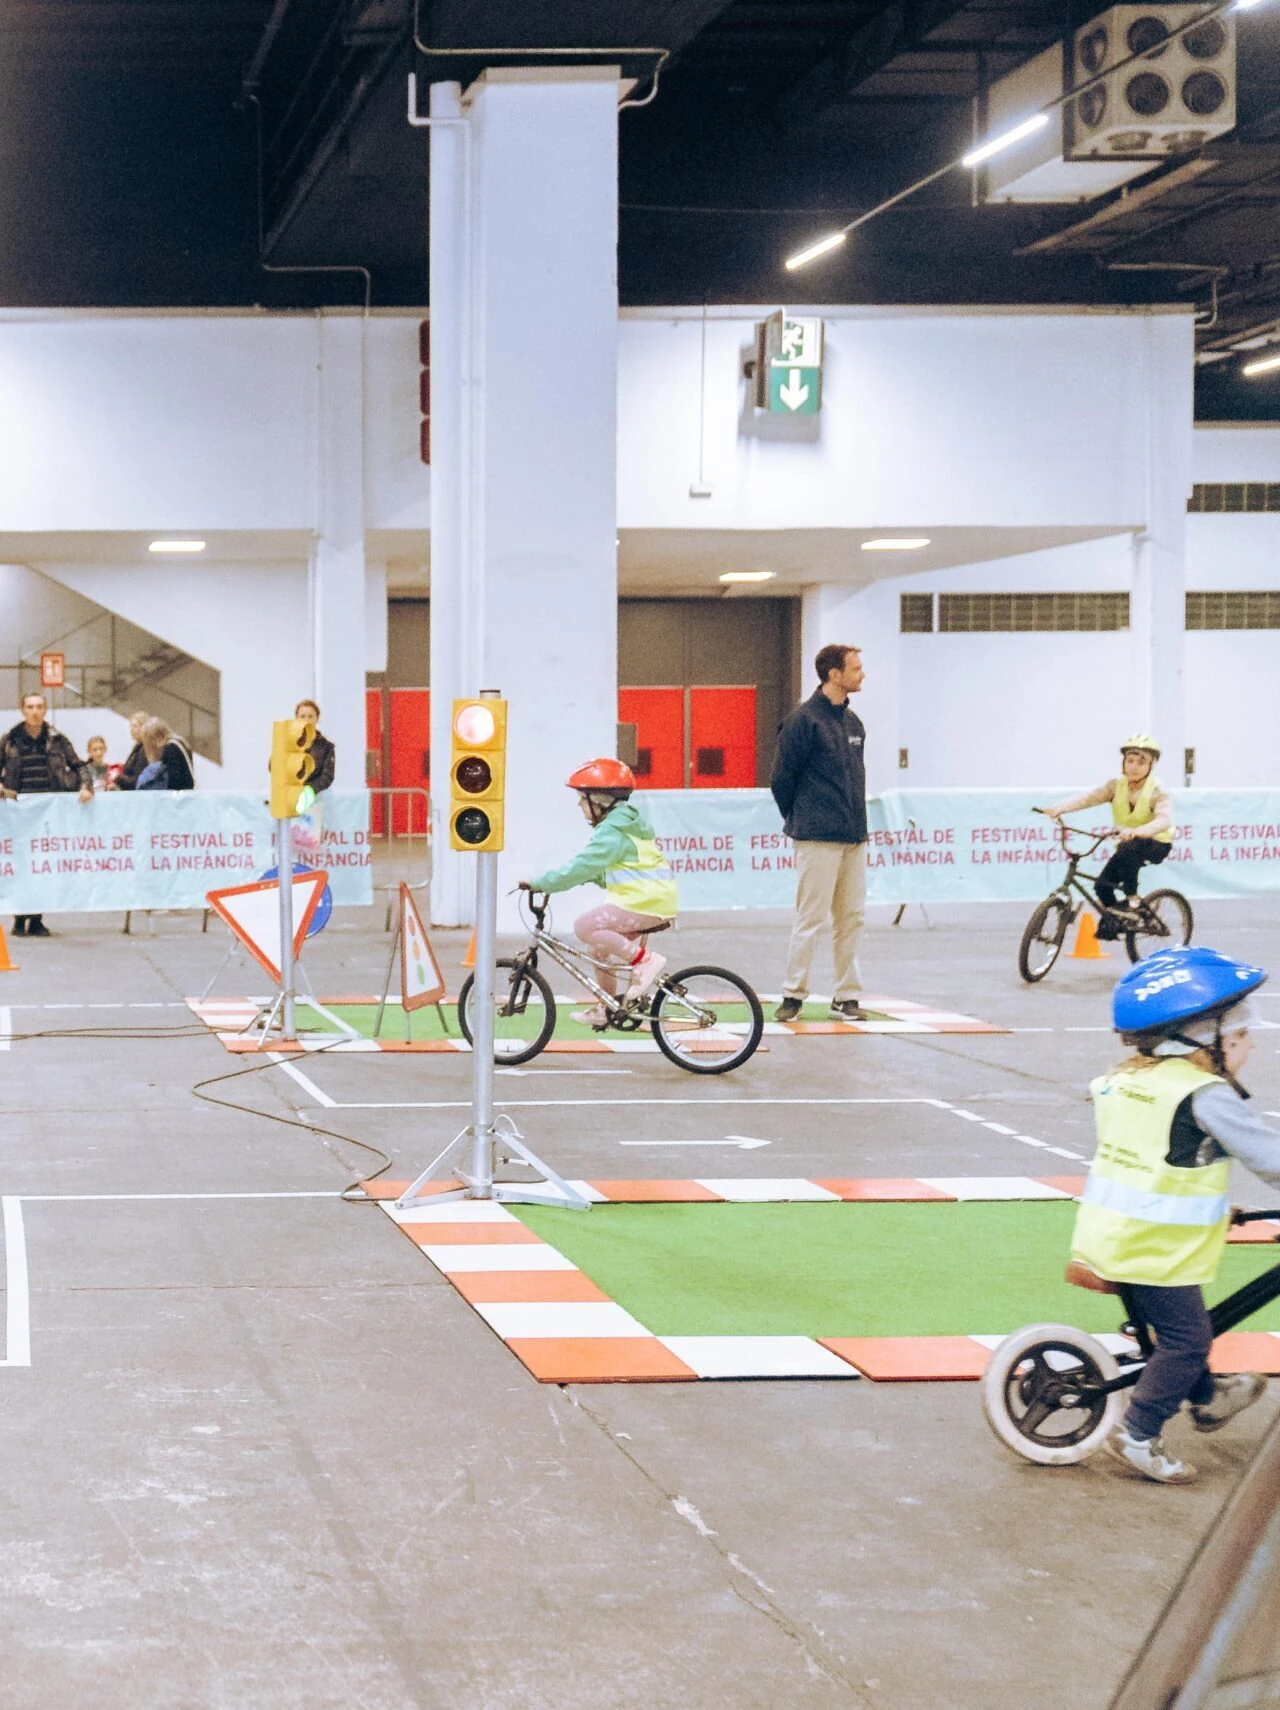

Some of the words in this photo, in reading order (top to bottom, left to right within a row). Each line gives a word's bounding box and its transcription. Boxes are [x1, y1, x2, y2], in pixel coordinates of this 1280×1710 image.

[30, 835, 106, 853] FESTIVAL
[112, 834, 134, 850] DE
[150, 832, 227, 850] FESTIVAL
[233, 831, 253, 847] DE
[655, 835, 708, 852] STIVAL
[713, 834, 734, 851] DE
[933, 828, 954, 844] DE
[971, 827, 1047, 844] FESTIVAL
[150, 856, 172, 870] LA
[176, 851, 255, 871] INFÀNCIA
[667, 853, 734, 872] NFÀNCIA
[866, 852, 886, 867] LA
[971, 849, 991, 864] LA
[1210, 847, 1230, 861] LA
[31, 859, 51, 874] LA
[57, 853, 134, 873] INFÀNCIA
[751, 855, 772, 871] LA
